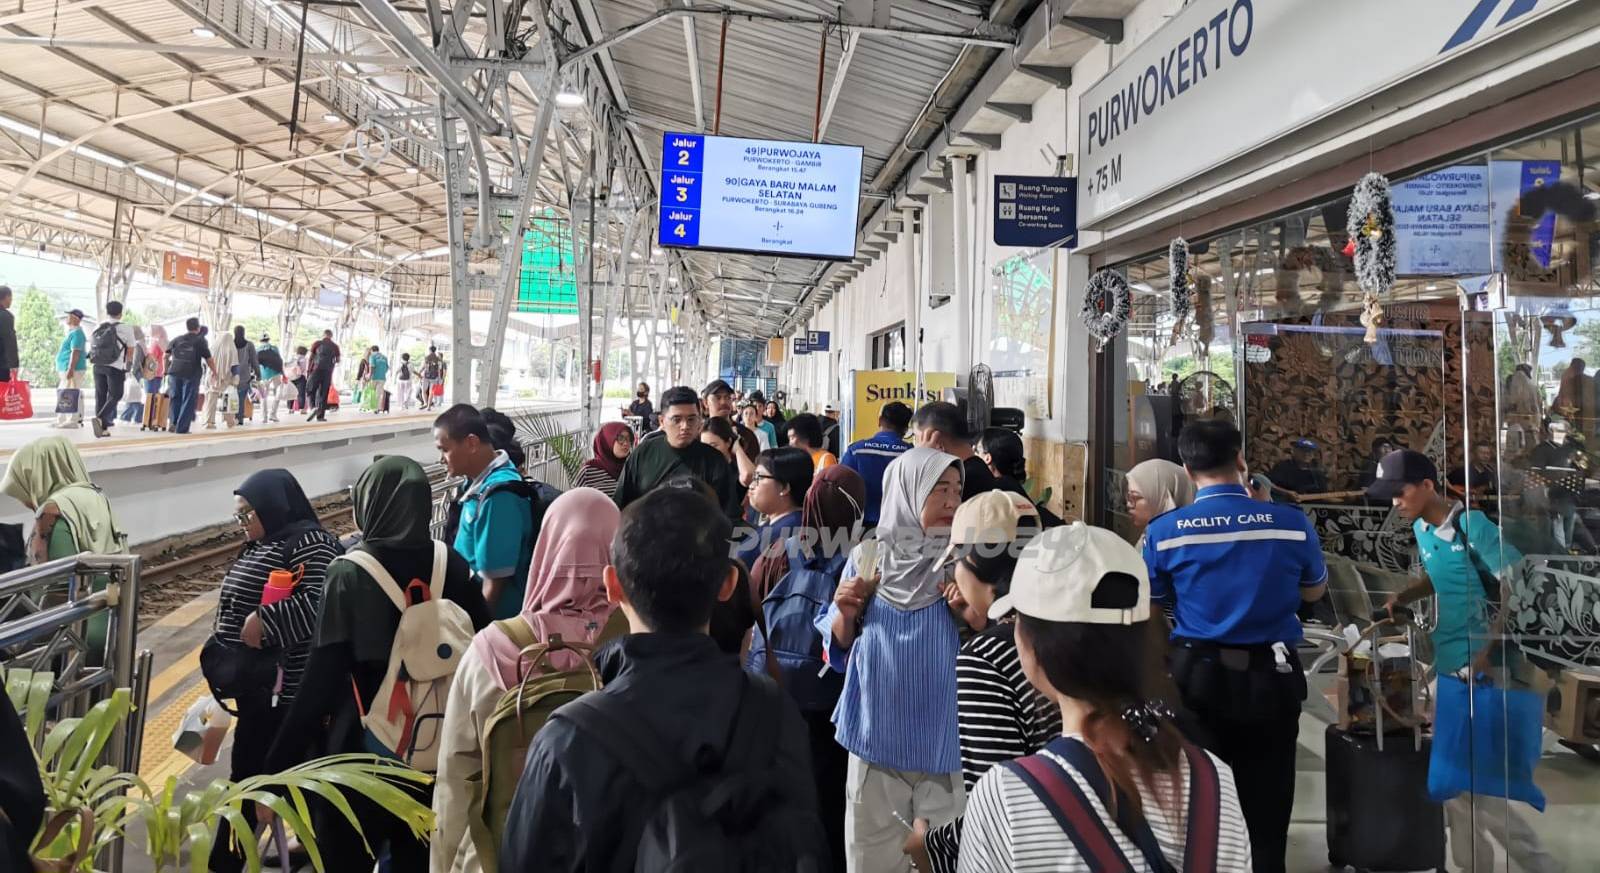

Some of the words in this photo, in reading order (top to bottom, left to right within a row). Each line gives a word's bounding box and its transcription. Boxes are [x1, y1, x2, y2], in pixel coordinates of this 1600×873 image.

[1088, 0, 1253, 155] PURWOKERTO
[672, 138, 697, 148] Jalur
[678, 150, 690, 166] 2
[743, 156, 791, 166] PURWOKERTO
[795, 160, 822, 168] GAMBIR
[757, 165, 790, 173] Berangkat
[1096, 164, 1108, 194] 75
[1111, 153, 1122, 186] M
[670, 175, 695, 185] Jalur
[724, 177, 768, 188] 90|GAYA
[770, 180, 796, 189] BARU
[798, 182, 837, 193] MALAM
[1018, 183, 1041, 193] Ruang
[1042, 184, 1068, 193] Tunggu
[676, 186, 688, 202] 3
[758, 190, 803, 200] SELATAN
[721, 196, 769, 206] PURWOKERTO
[773, 200, 808, 208] SURABAYA
[809, 202, 838, 210] GUBENG
[755, 206, 786, 214] Berangkat
[1018, 204, 1041, 212] Ruang
[1041, 204, 1061, 214] Kerja
[668, 211, 693, 221] Jalur
[1018, 213, 1048, 221] Bersama
[674, 223, 687, 238] 4
[761, 237, 793, 246] Berangkat
[1177, 516, 1232, 530] FACILITY
[1237, 513, 1274, 524] CARE
